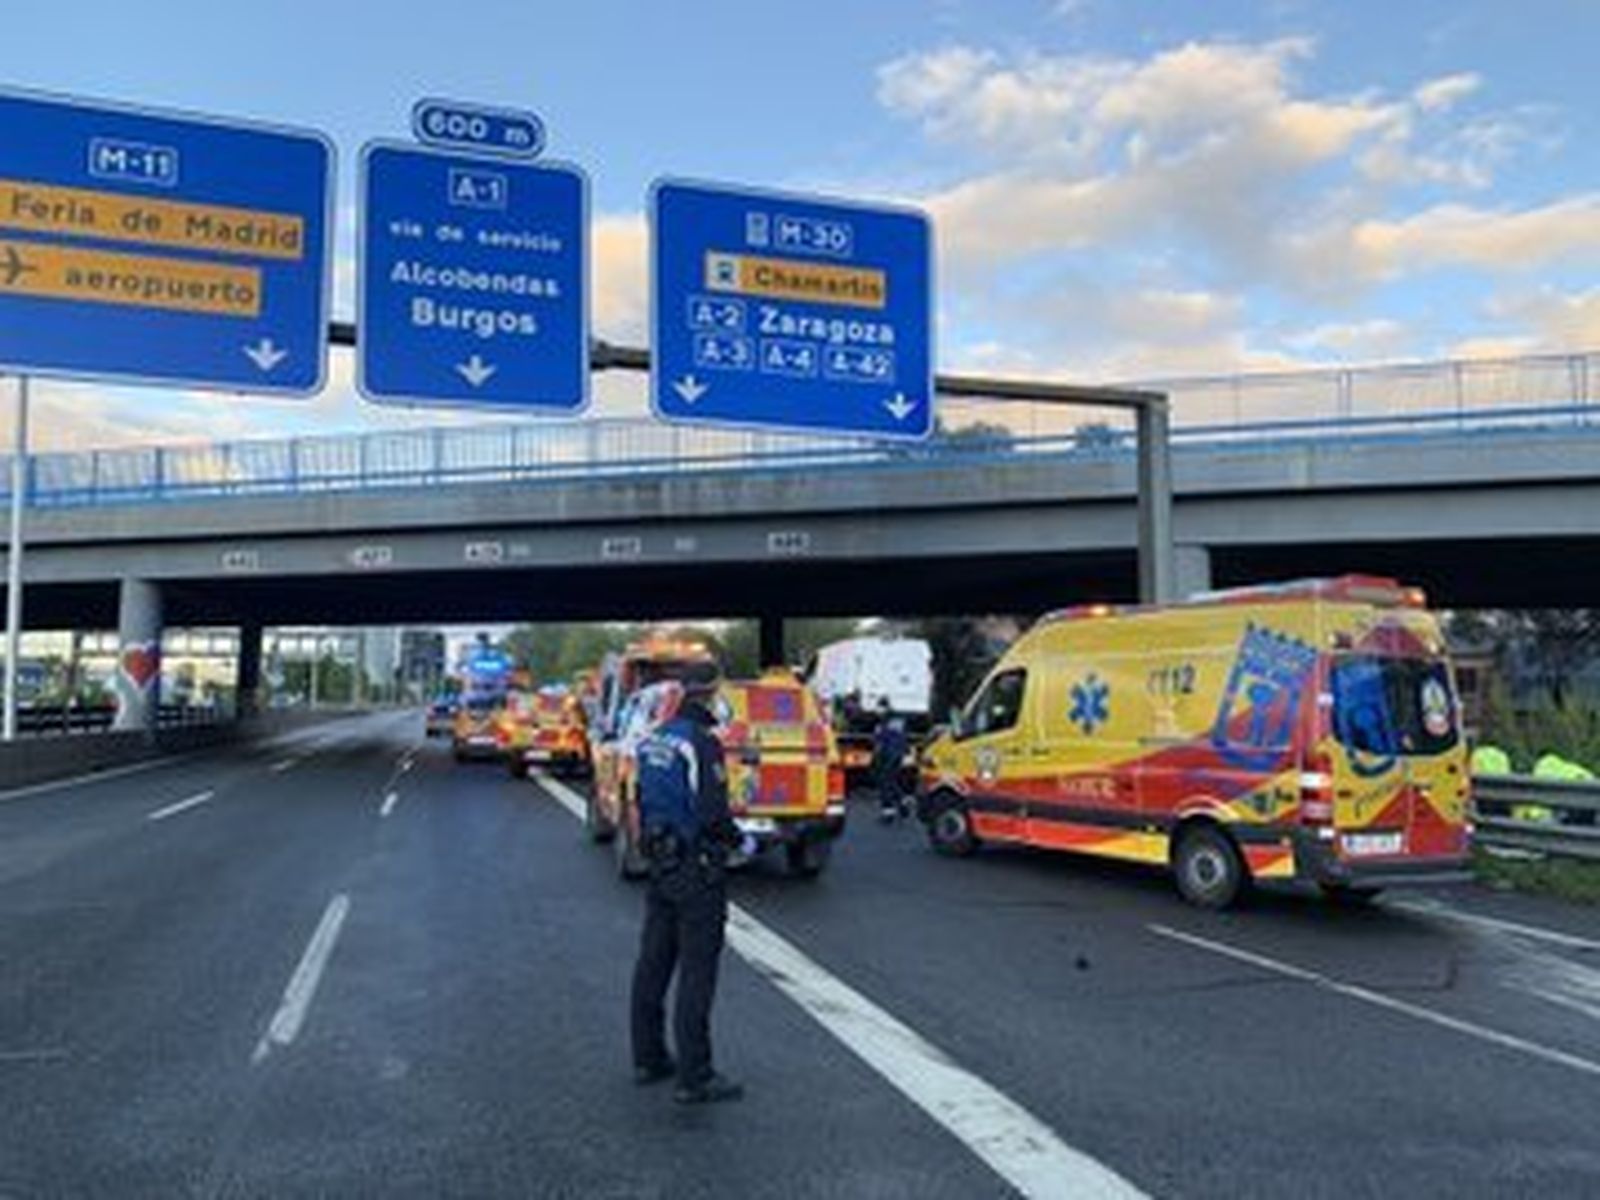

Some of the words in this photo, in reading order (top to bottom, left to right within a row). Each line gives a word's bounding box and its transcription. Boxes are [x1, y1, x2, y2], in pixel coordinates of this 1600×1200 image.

[426, 111, 488, 140] 600
[503, 125, 530, 145] m
[99, 146, 170, 177] M-11
[455, 176, 501, 201] A-1
[11, 191, 96, 223] Feria
[121, 208, 162, 233] de
[185, 214, 300, 249] Madrid
[780, 219, 848, 250] M-30
[64, 266, 256, 305] aeropuerto
[390, 260, 561, 298] Alcobendas
[411, 297, 538, 338] Burgos
[696, 303, 740, 327] A-2
[759, 304, 895, 344] Zaragoza
[767, 344, 811, 369] A-4
